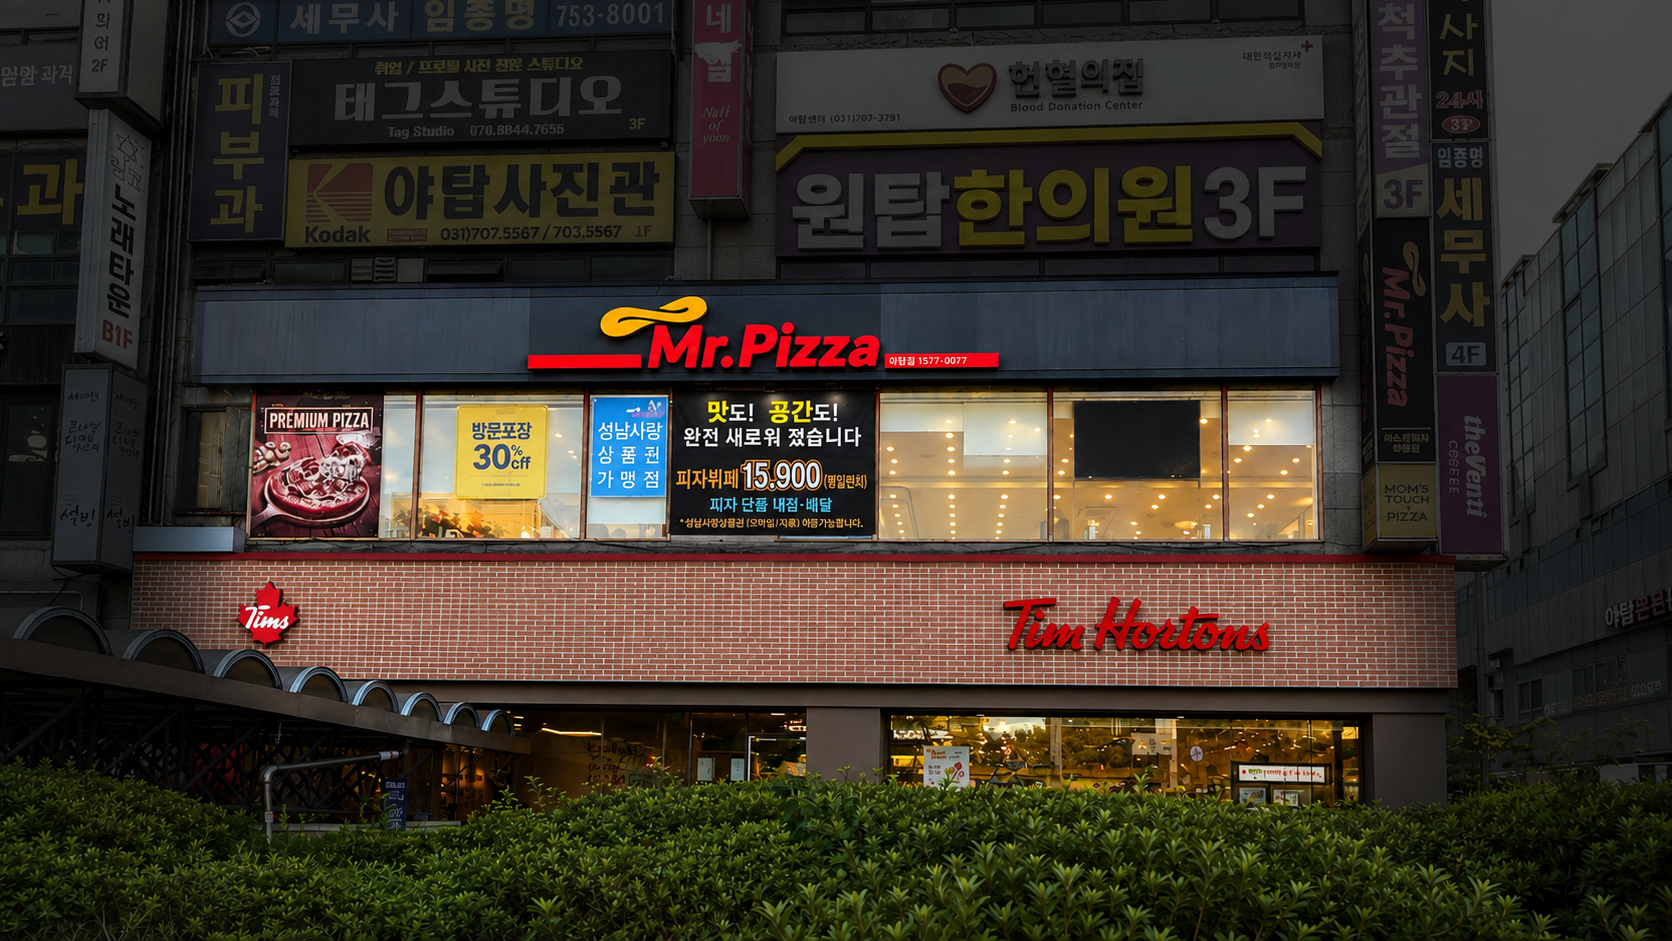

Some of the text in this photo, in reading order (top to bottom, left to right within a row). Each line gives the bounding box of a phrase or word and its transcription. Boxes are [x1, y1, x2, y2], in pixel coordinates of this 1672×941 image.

[289, 1, 399, 35] 세무사
[424, 0, 535, 32] 임종명
[1439, 0, 1478, 76] 사지
[91, 59, 109, 72] 2F
[463, 58, 491, 73] 사진
[526, 56, 584, 71] 스튜디오
[1008, 58, 1143, 98] 헌혈의집
[1376, 3, 1423, 159] 척추관절
[334, 76, 622, 121] 태그스튜디오
[1010, 100, 1143, 112] Blood Donation Center
[628, 117, 647, 130] 3F
[708, 119, 724, 131] of
[830, 113, 901, 124] (031)707-3791
[387, 126, 409, 139] Tag
[413, 125, 454, 137] Studio
[700, 134, 730, 146] yoon
[210, 73, 265, 234] 피부과
[1437, 146, 1484, 169] 임종명
[384, 161, 660, 220] 야탑사진관
[1383, 179, 1424, 209] 3F
[305, 225, 371, 244] Kodak
[439, 226, 539, 241] 031)707.5567
[553, 225, 623, 239] 703.5567
[634, 225, 652, 237] 1F
[106, 183, 137, 320] 노래타운
[1436, 177, 1490, 327] 세무사
[101, 318, 135, 350] B1F
[918, 356, 967, 365] 1577-0077
[1451, 345, 1480, 364] 4F
[269, 412, 369, 429] PREMIUM PIZZA
[707, 400, 838, 424] 맛도! 공간도!
[471, 422, 532, 440] 방문포장
[597, 421, 663, 441] 성남사랑
[683, 427, 719, 448] 완전
[725, 427, 781, 448] 새로워
[676, 468, 739, 490] 피자뷔페
[1384, 483, 1430, 494] MOM'S
[709, 497, 738, 513] 피자
[1384, 495, 1430, 504] TOUCH
[1387, 512, 1429, 522] PIZZA
[244, 605, 290, 630] Tims
[1003, 596, 1270, 651] Tim Hortons
